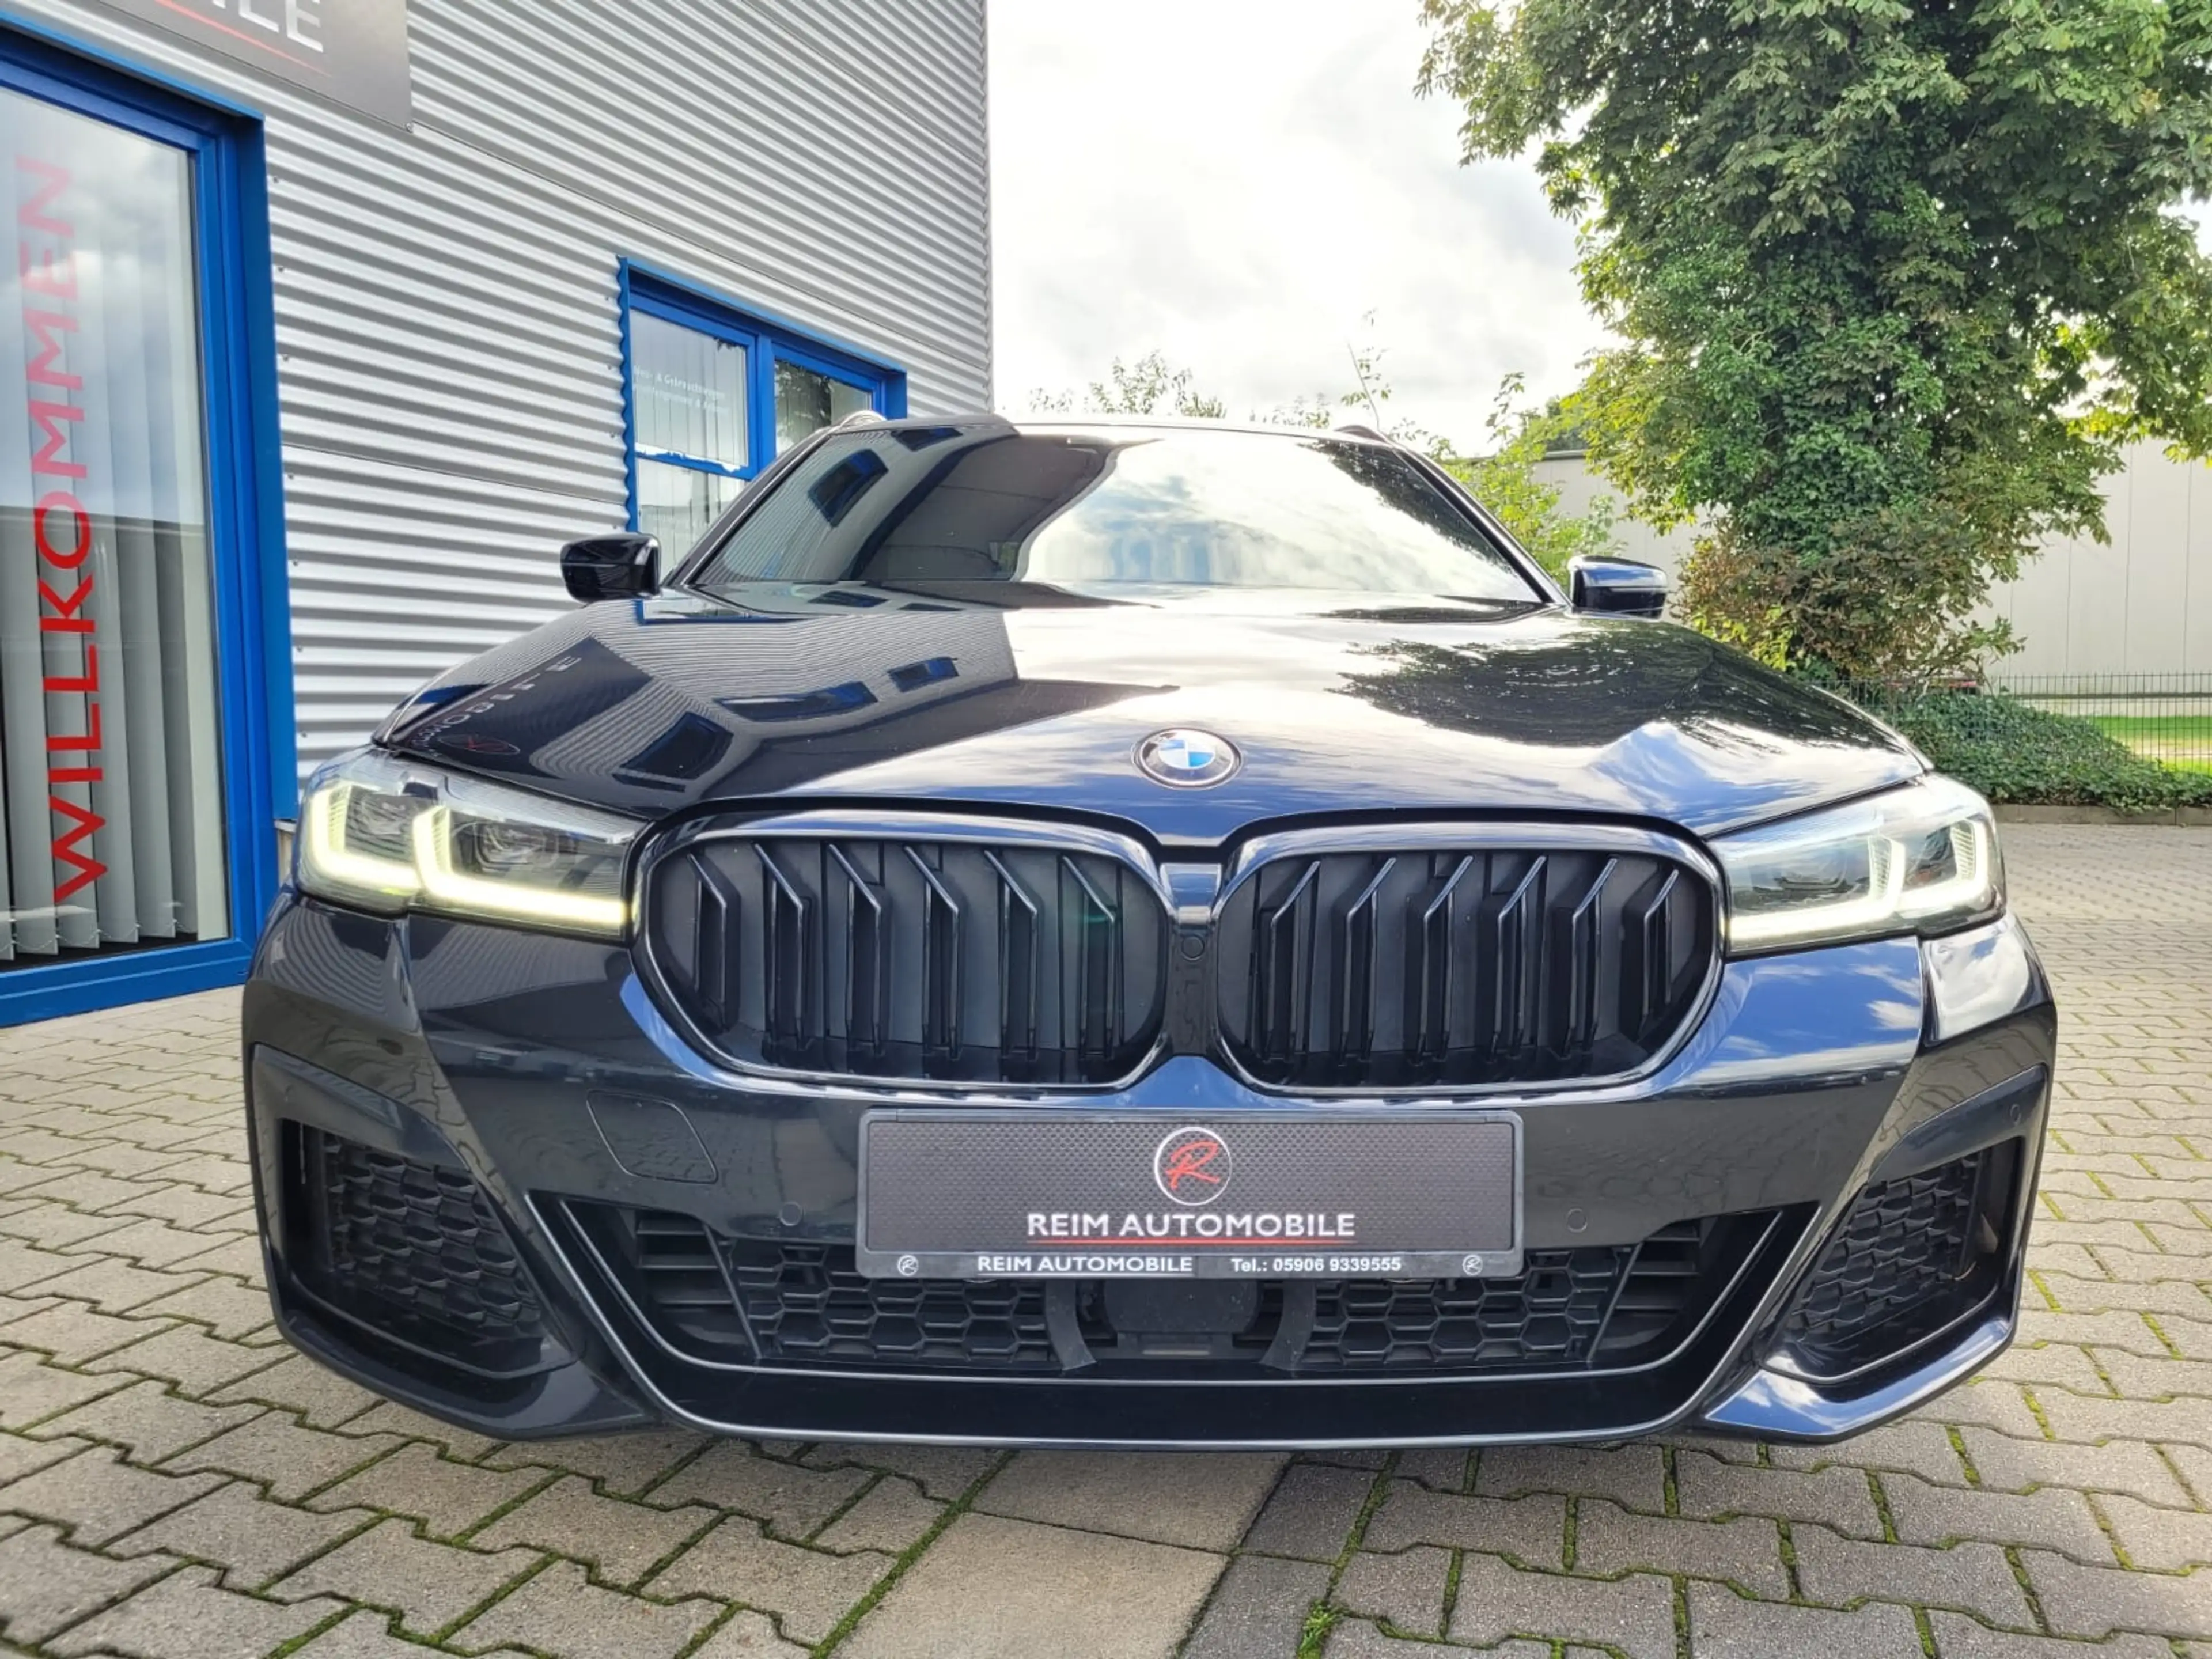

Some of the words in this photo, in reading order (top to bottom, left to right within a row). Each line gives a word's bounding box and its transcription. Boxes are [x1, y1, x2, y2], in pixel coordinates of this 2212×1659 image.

[16, 153, 108, 903] WILLKOMMEN
[1027, 1213, 1109, 1236] REIM
[1119, 1213, 1355, 1237] AUTOMOBILE
[978, 1256, 1032, 1271] REIM
[1038, 1256, 1193, 1271] AUTOMOBILE
[1231, 1258, 1267, 1272] Tel.:
[1272, 1257, 1324, 1272] 05906
[1328, 1256, 1402, 1271] 9339555
